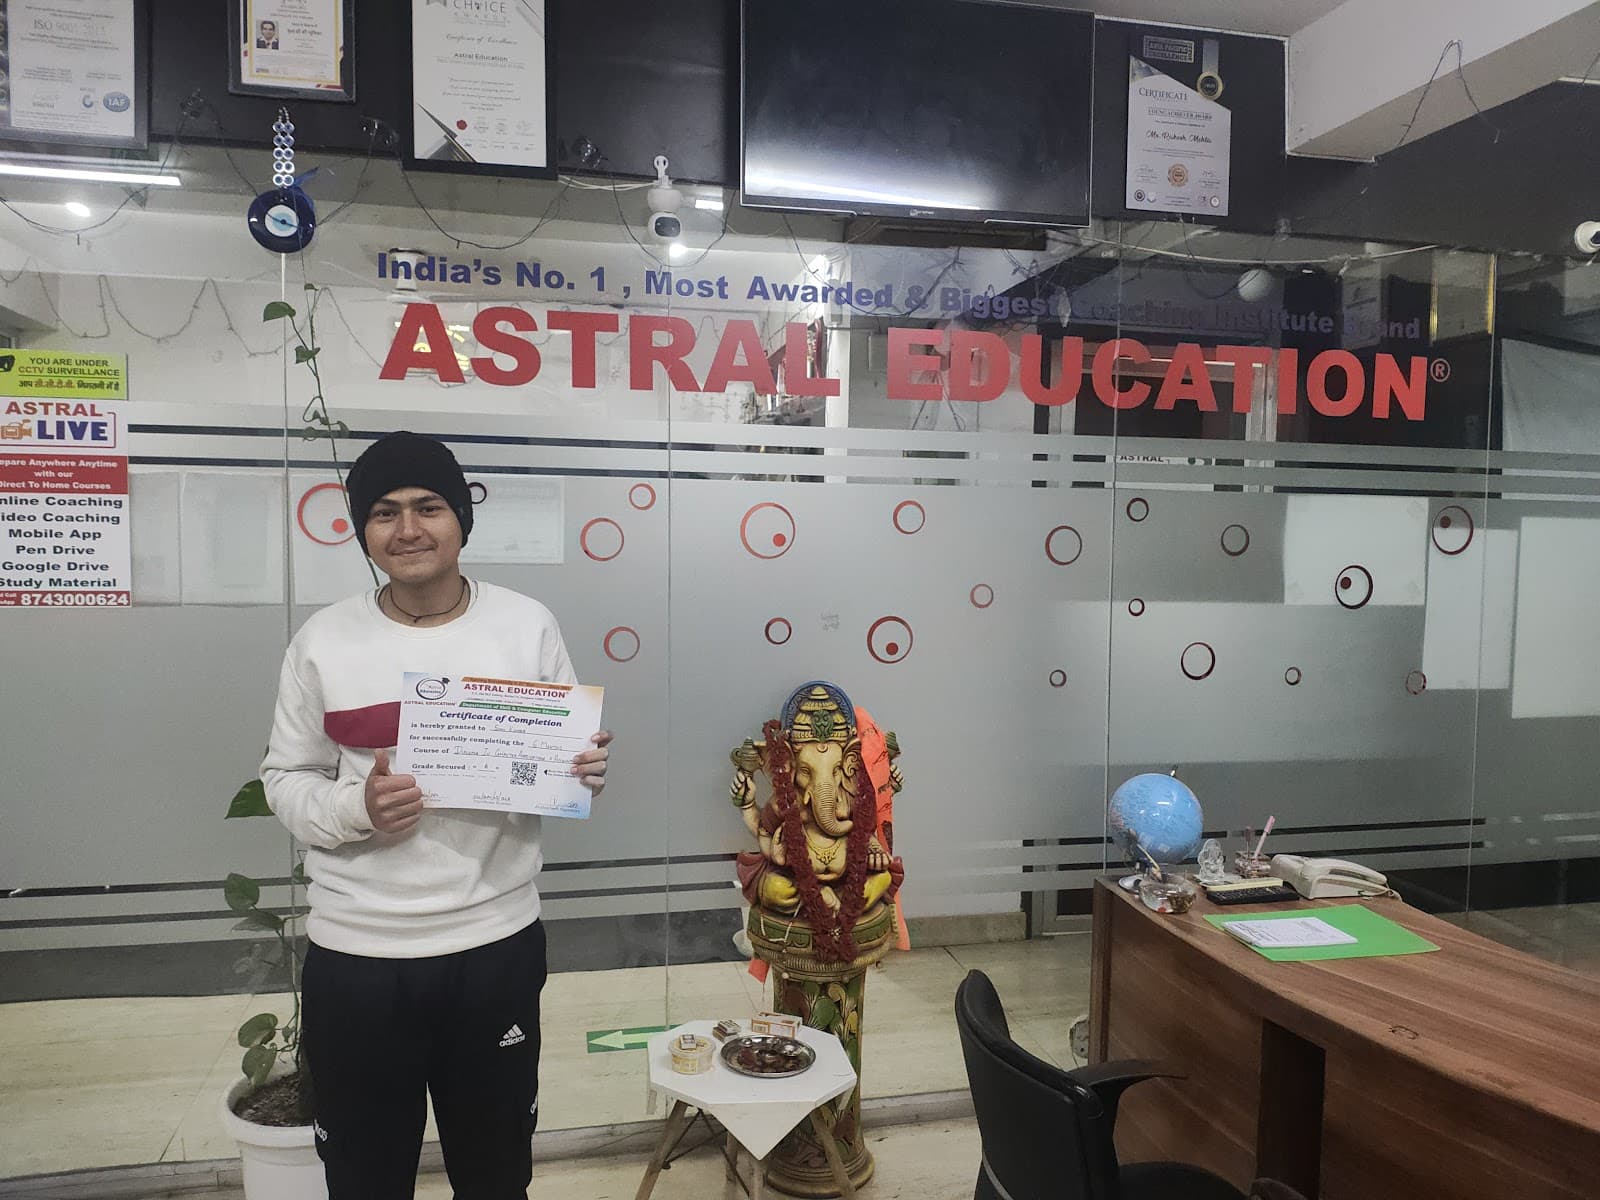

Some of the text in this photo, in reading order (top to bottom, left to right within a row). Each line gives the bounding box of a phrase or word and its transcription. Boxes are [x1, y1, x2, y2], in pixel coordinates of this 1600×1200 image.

[377, 252, 502, 286] India's
[516, 261, 576, 290] No.
[590, 266, 606, 292] 1
[645, 270, 729, 300] Most
[746, 275, 893, 309] Awarded
[904, 286, 929, 310] &
[940, 287, 1058, 319] Biggest
[378, 302, 841, 397] ASTRAL
[30, 357, 110, 368] YOU ARE UNDER
[18, 366, 120, 377] CCTV SURVEILLANCE
[5, 401, 104, 416] ASTRAL
[37, 419, 108, 441] LIVE
[0, 458, 119, 470] epare Anywhere Anytime
[33, 470, 56, 478] with
[28, 480, 41, 489] To
[41, 481, 71, 490] Home
[72, 481, 112, 490] Courses
[0, 496, 123, 510] nline Coaching
[0, 512, 121, 526] ideo Coaching
[8, 528, 103, 541] Mobile App
[15, 545, 96, 556] Pen Drive
[1, 561, 110, 574] Google Drive
[0, 577, 118, 590] Study Material
[20, 593, 129, 606] 8743000624
[463, 683, 506, 693] ASTRAL
[439, 710, 563, 728] Certificate of Completion
[419, 722, 446, 731] hereby
[447, 723, 477, 732] granted
[421, 735, 468, 744] successfully
[469, 736, 512, 747] completing
[436, 763, 466, 771] Secured
